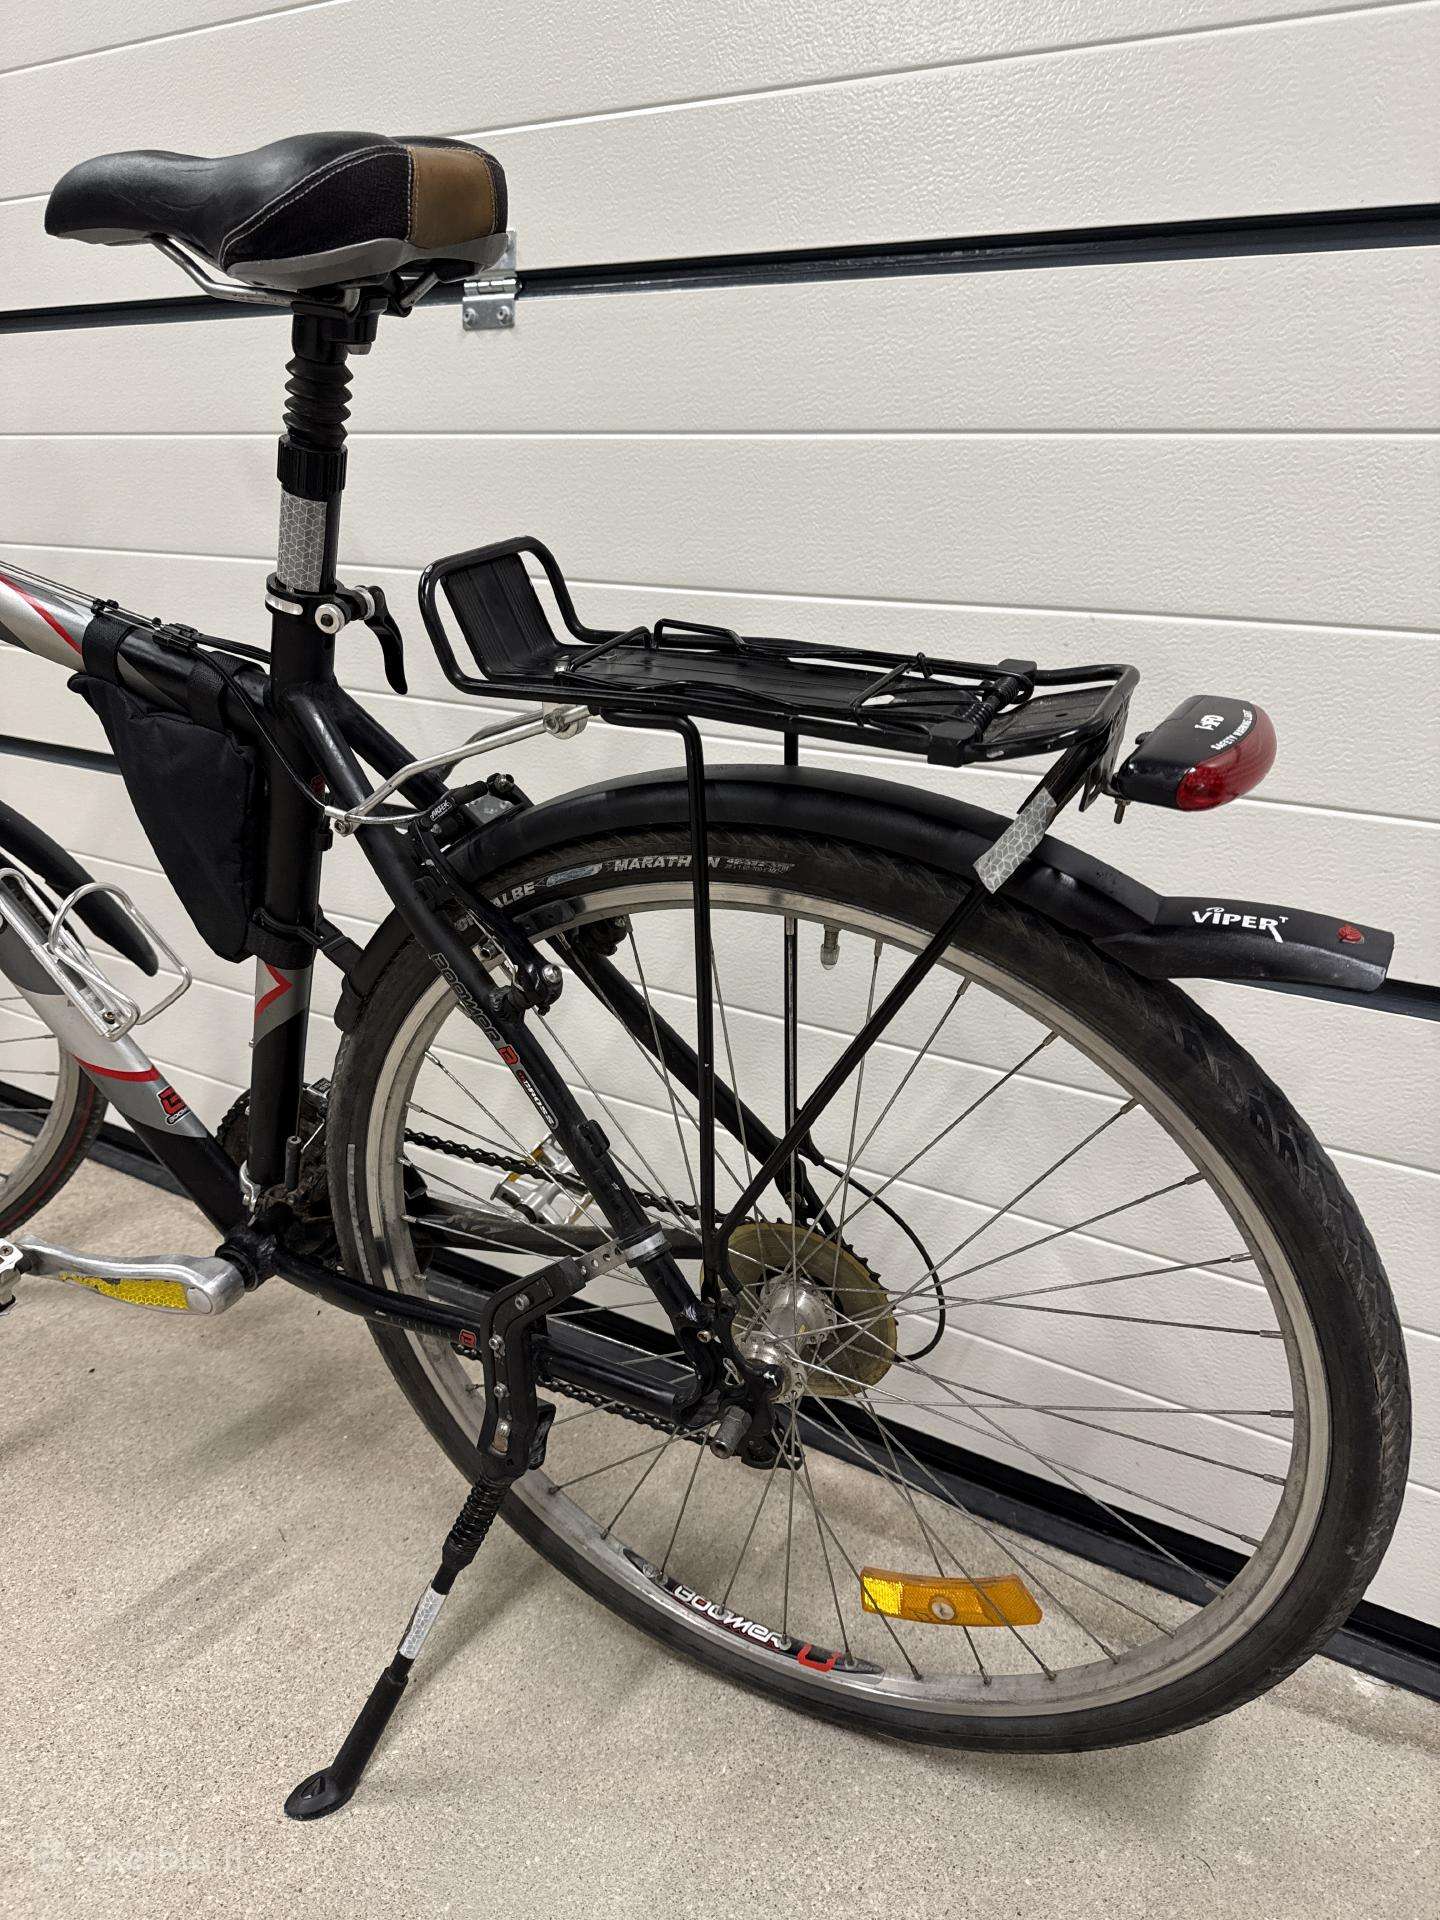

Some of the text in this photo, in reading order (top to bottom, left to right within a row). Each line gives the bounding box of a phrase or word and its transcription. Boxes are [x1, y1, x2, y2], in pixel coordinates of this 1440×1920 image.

[1210, 734, 1238, 750] SAFETY
[613, 854, 720, 872] MARATHN
[1191, 906, 1284, 943] VIPER
